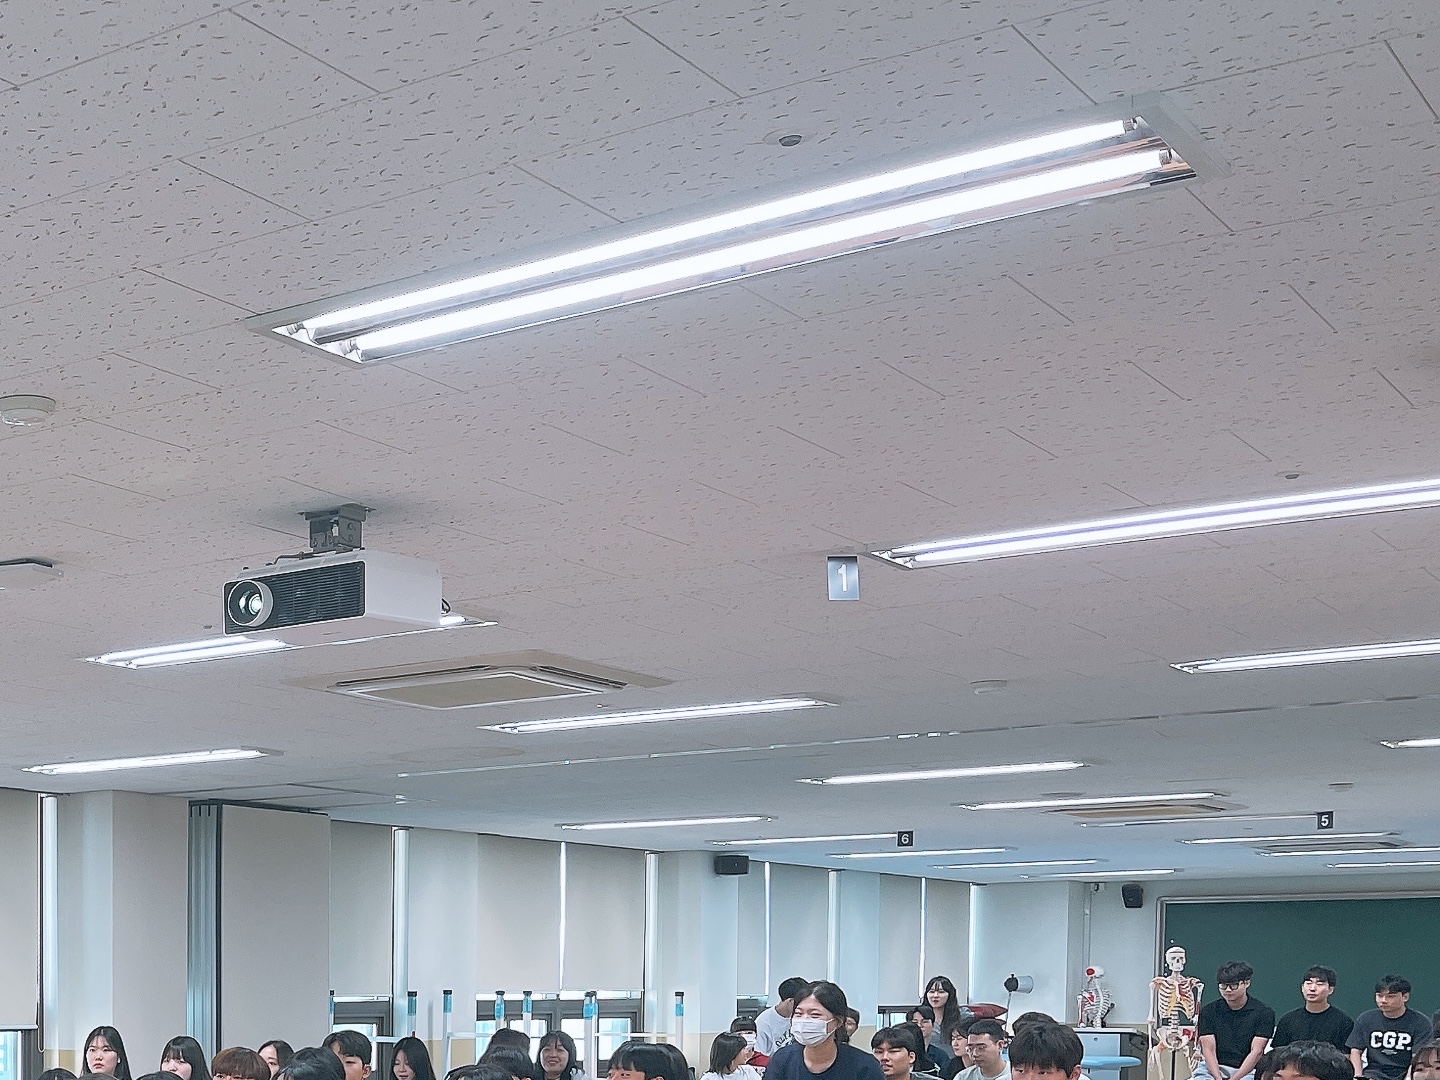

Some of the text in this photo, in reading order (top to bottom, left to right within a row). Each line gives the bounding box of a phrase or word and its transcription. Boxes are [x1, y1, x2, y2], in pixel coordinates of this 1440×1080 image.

[837, 563, 848, 592] 1
[1320, 814, 1330, 827] 5
[901, 833, 910, 845] 6
[1370, 1031, 1412, 1051] CGP.
